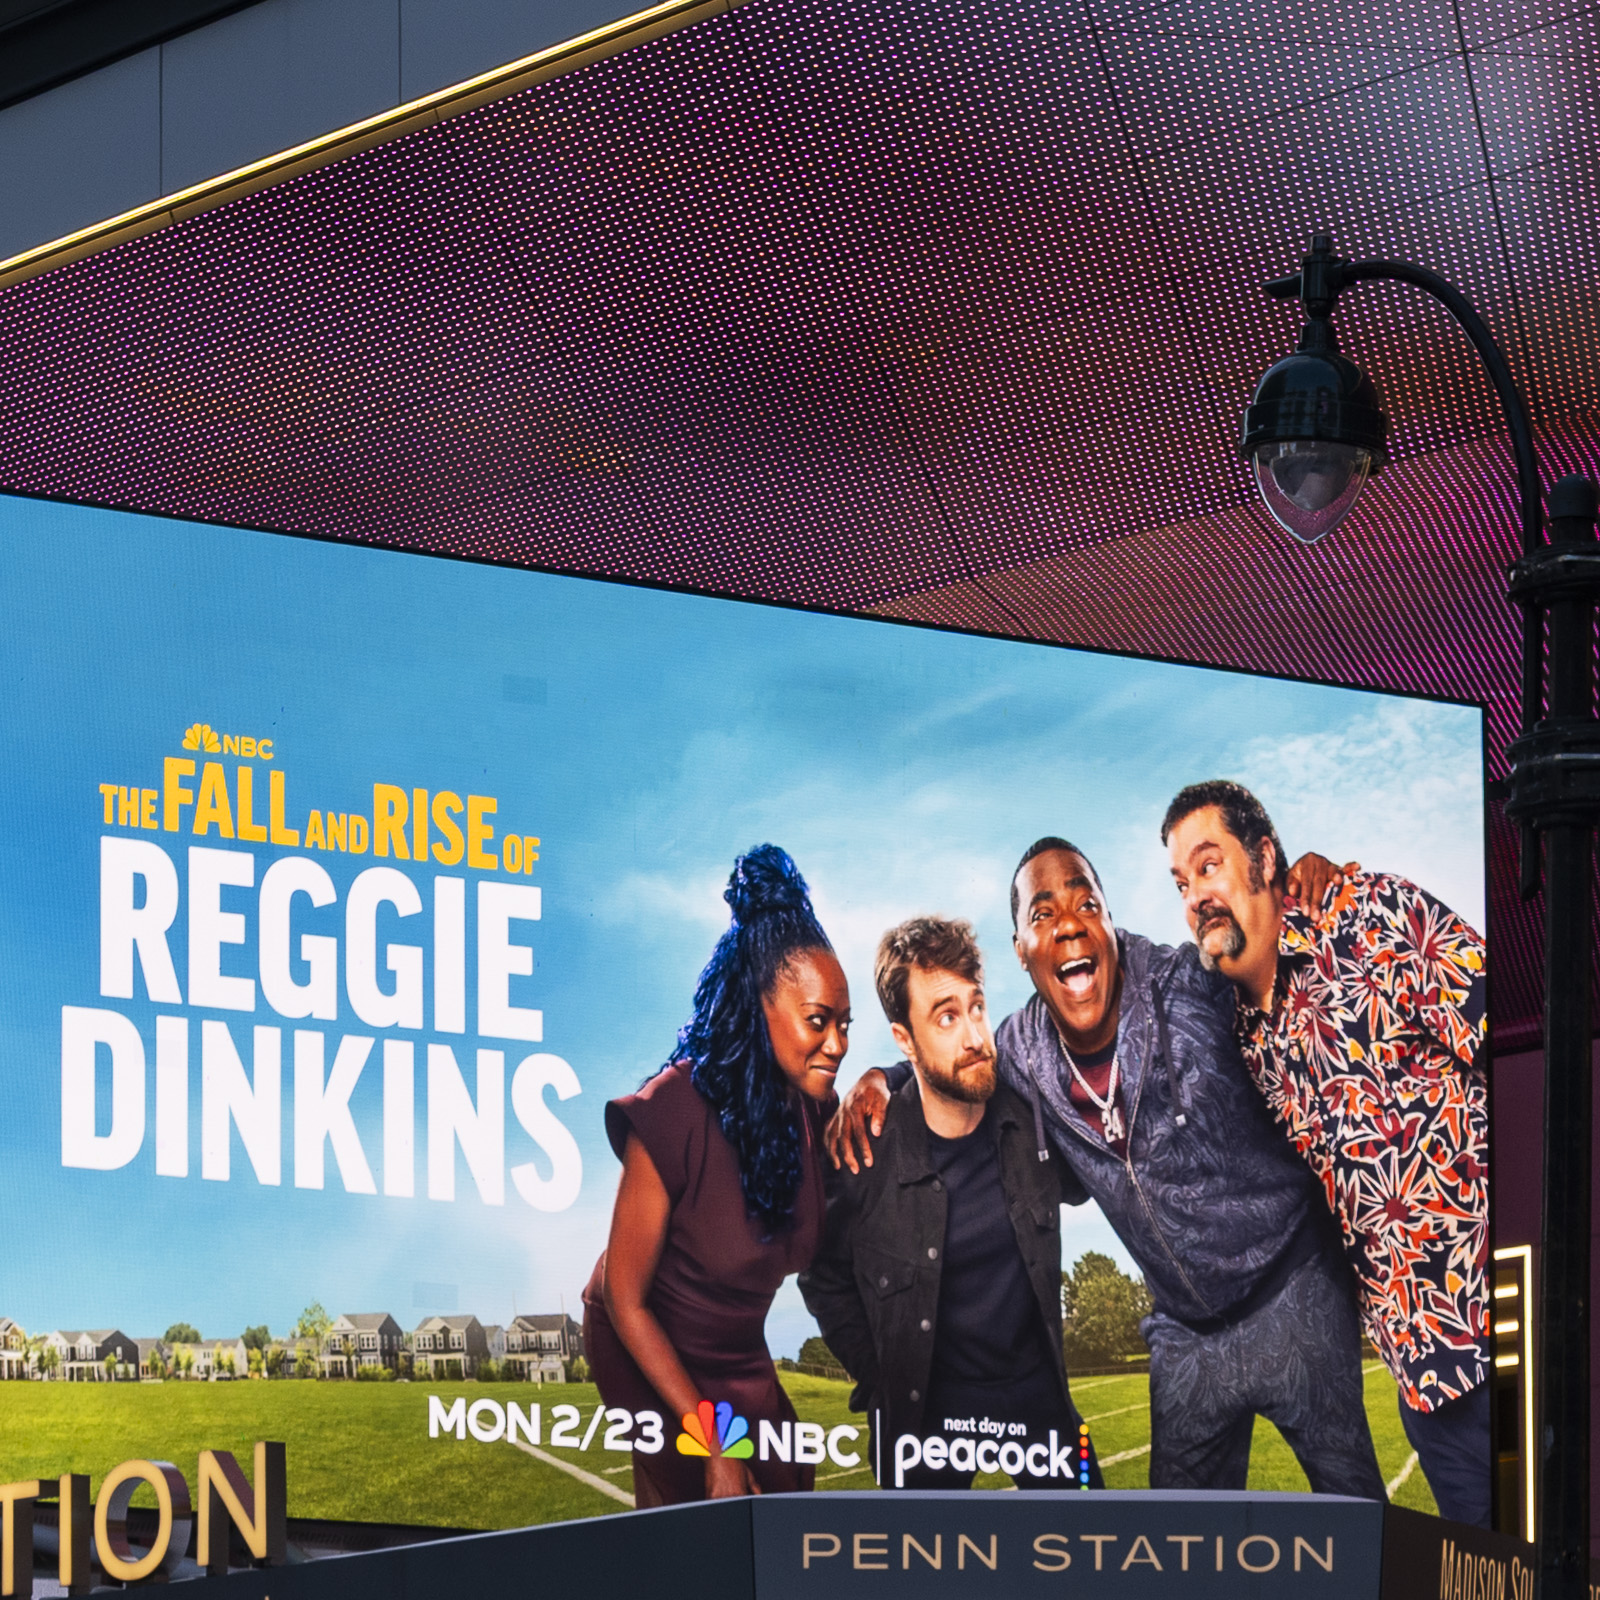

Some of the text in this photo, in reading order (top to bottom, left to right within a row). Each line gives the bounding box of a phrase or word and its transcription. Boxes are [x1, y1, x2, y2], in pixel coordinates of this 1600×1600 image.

[223, 733, 275, 760] NBC
[99, 757, 541, 875] THE FALL AND RISE OF
[100, 835, 542, 1042] REGGIE
[61, 1005, 582, 1213] DINKINS
[427, 1395, 861, 1468] MON 2/23 NBC
[895, 1429, 1075, 1488] peacock
[944, 1417, 1027, 1438] next day on
[803, 1533, 1334, 1572] PENN STATION
